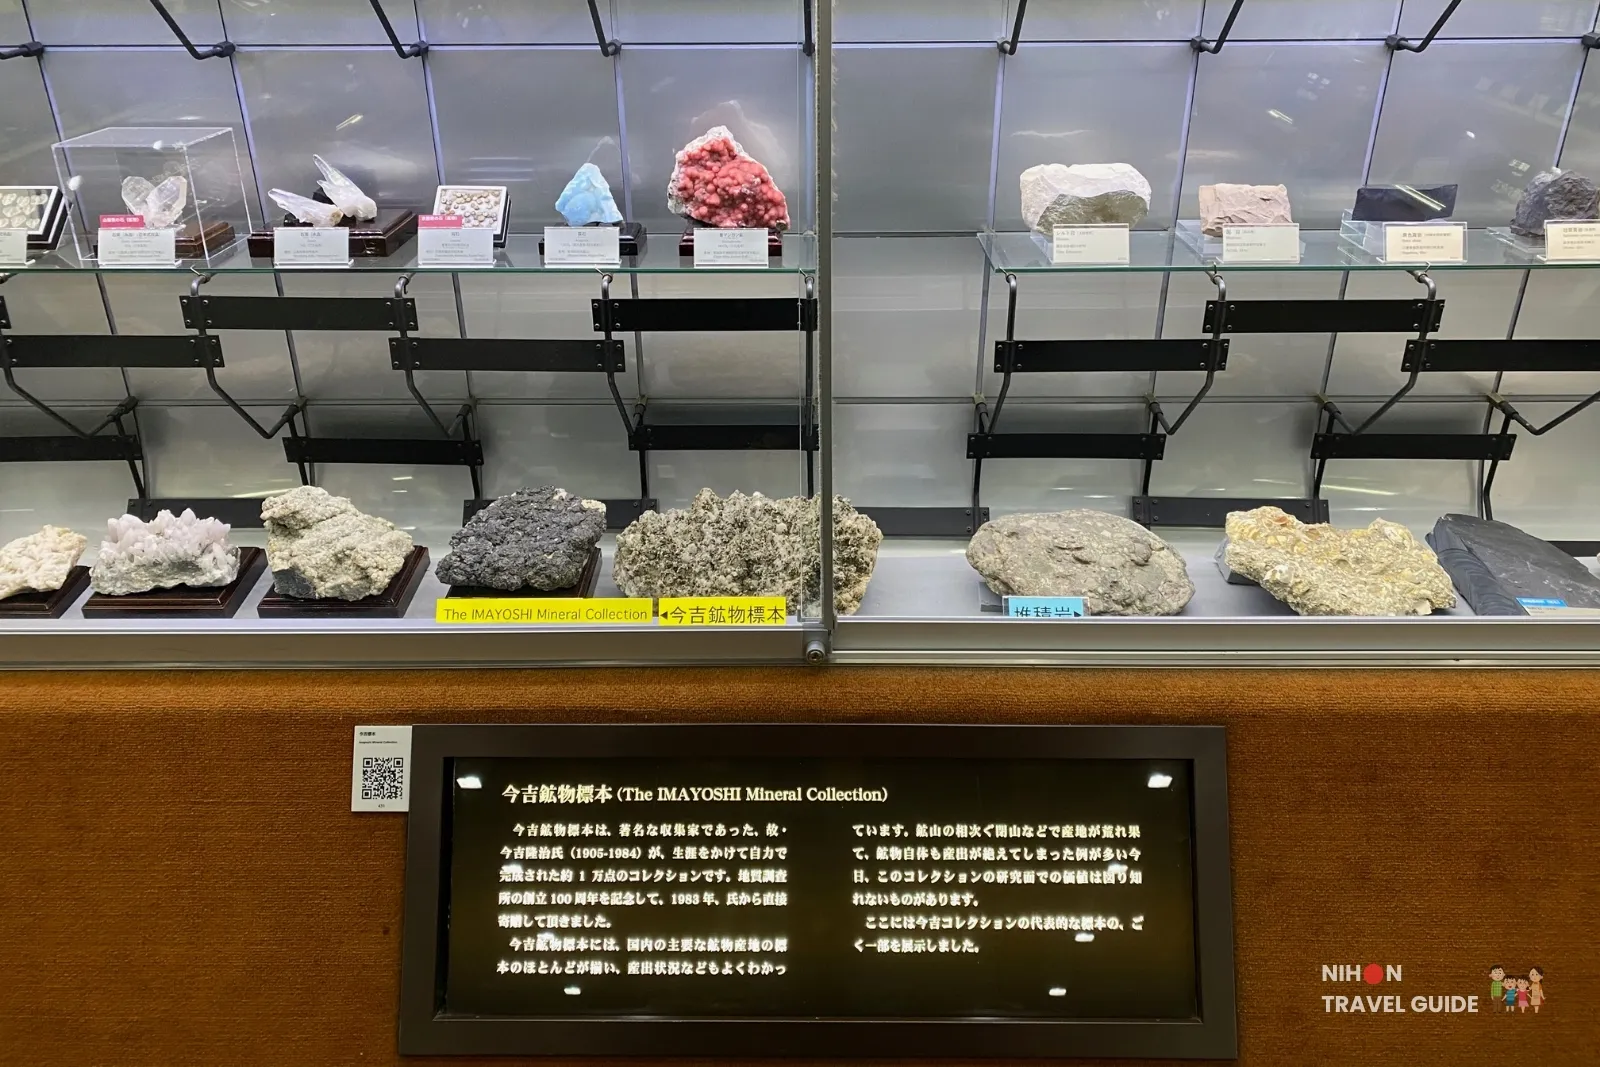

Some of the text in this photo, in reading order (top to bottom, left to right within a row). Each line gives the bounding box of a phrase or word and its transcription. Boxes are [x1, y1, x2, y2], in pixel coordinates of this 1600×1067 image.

[444, 607, 648, 621] The IMAYOSHI Mineral Collection
[670, 605, 786, 624] 今吉鉱物標本
[501, 783, 613, 805] 今吉鉱物標本
[657, 786, 742, 802] IMAYOSHI
[746, 786, 803, 802] Mineral
[807, 787, 889, 804] Collection)
